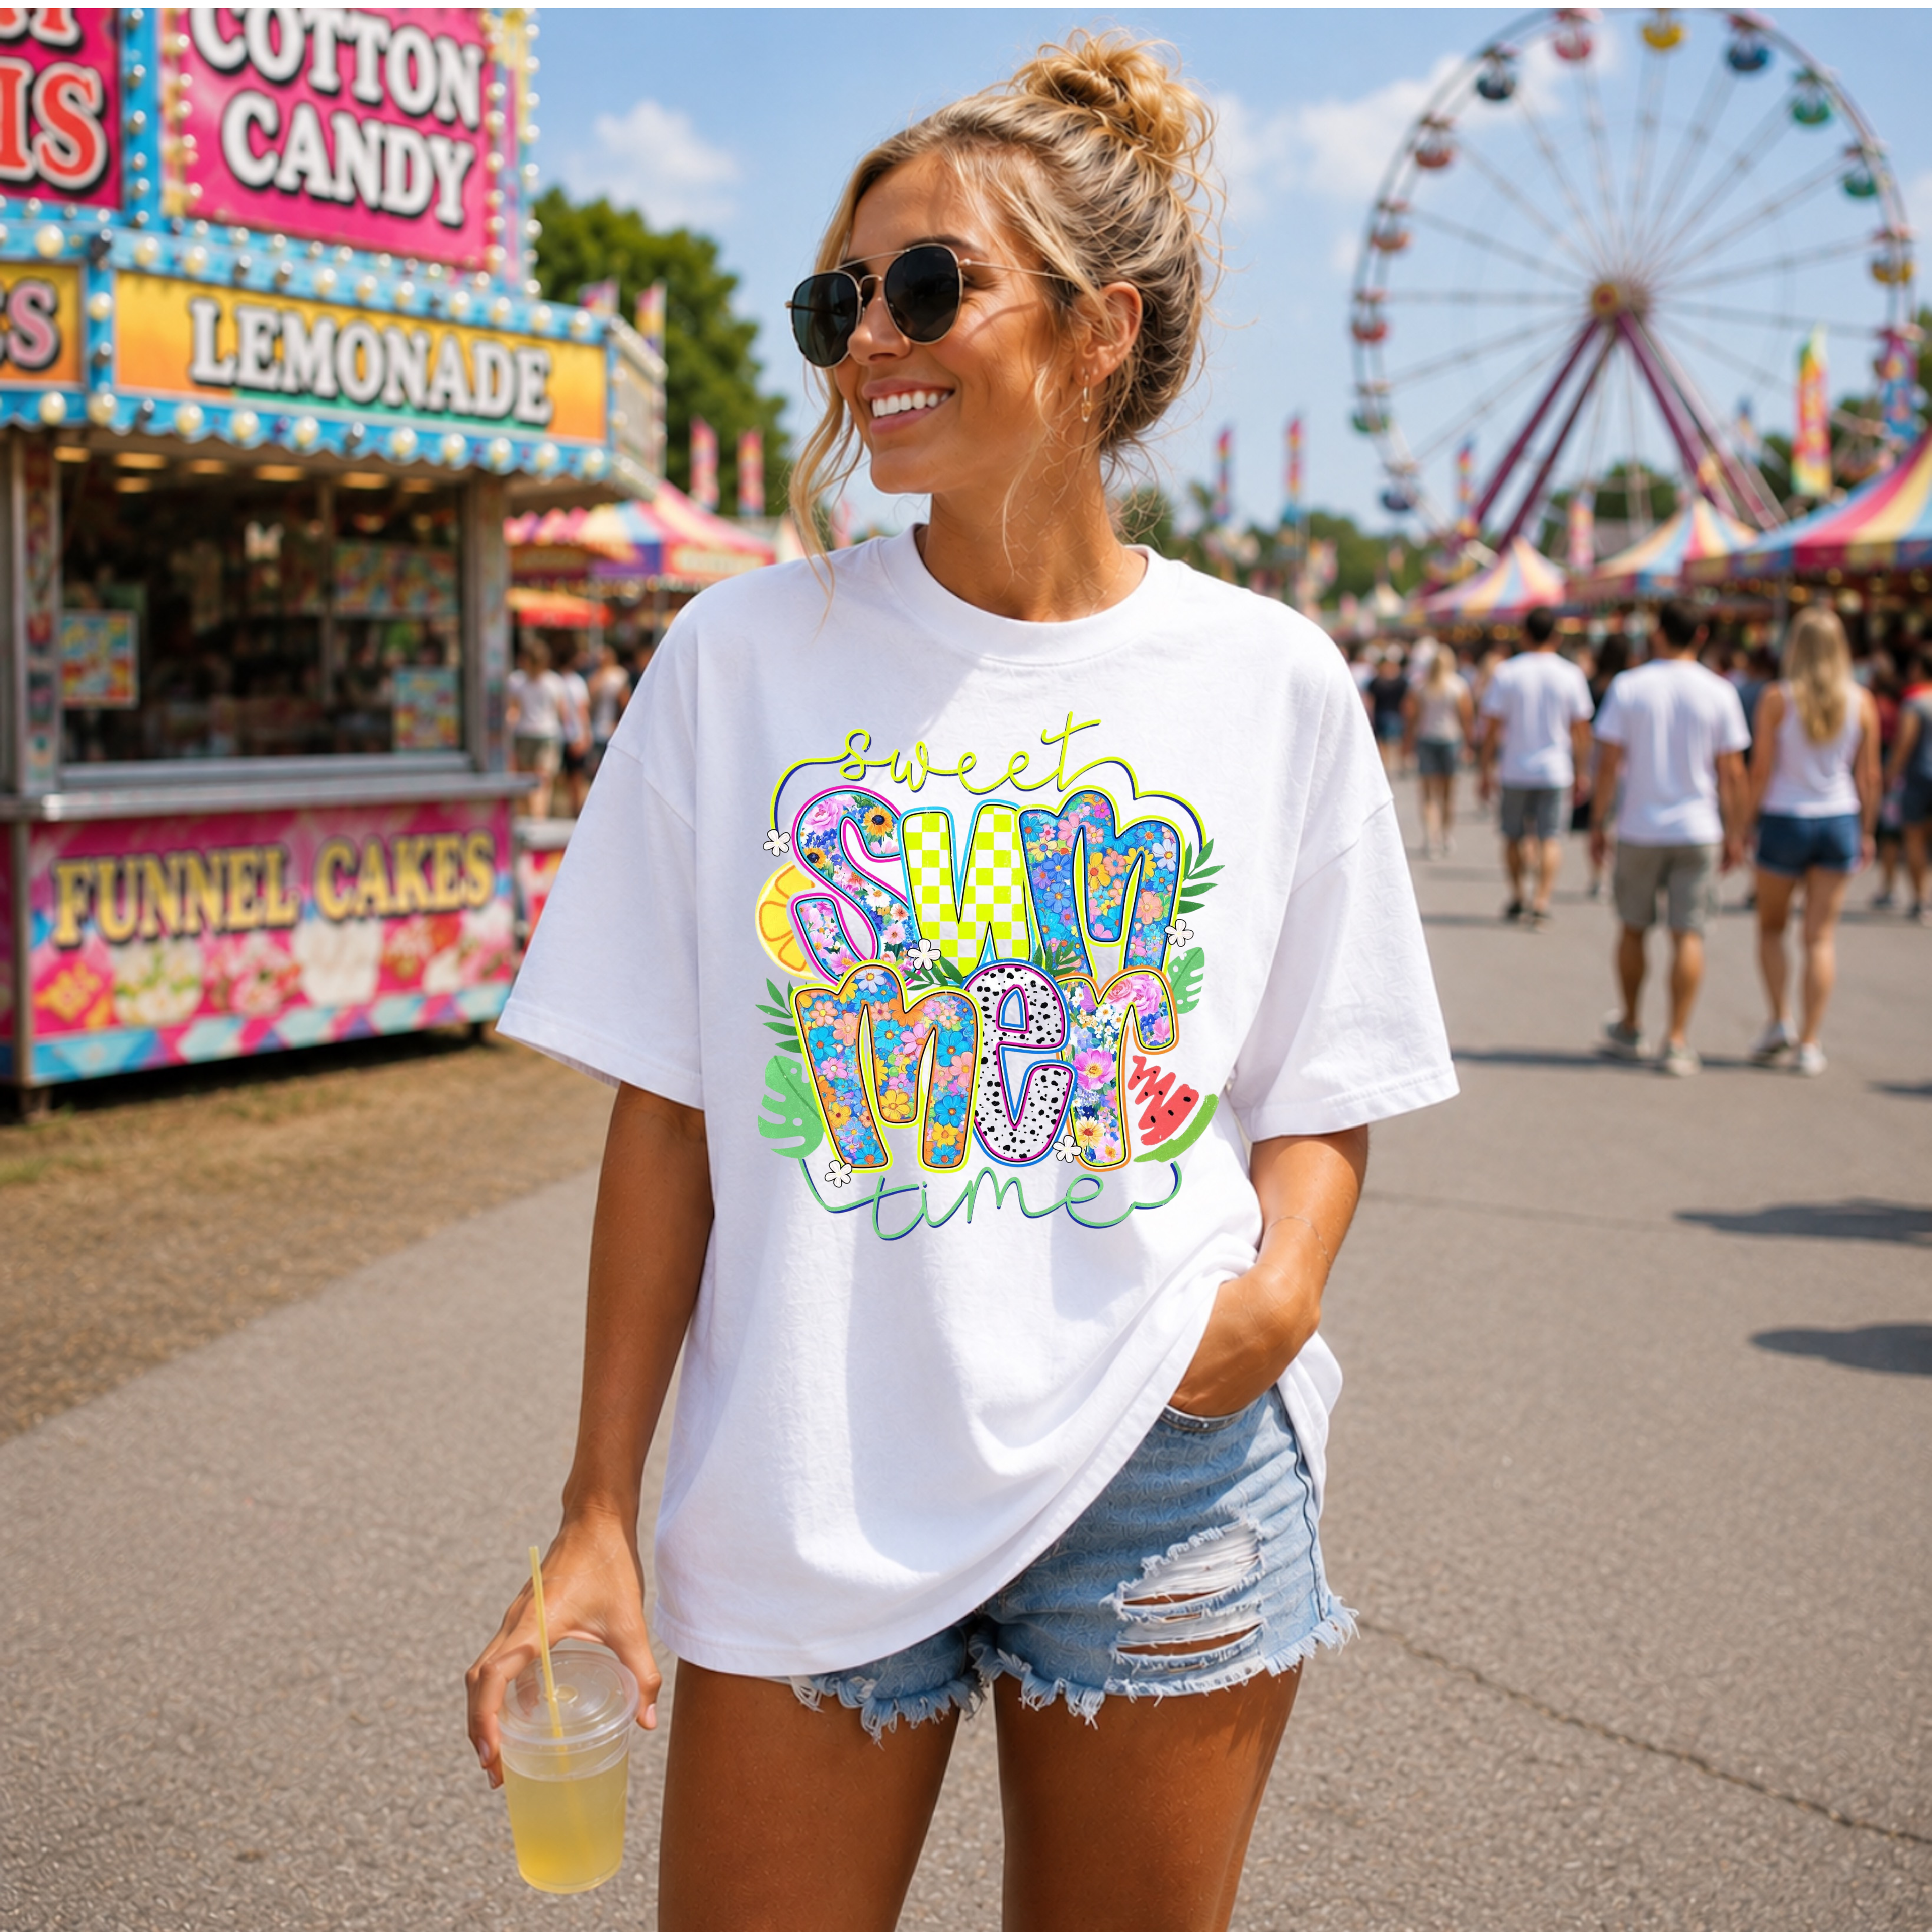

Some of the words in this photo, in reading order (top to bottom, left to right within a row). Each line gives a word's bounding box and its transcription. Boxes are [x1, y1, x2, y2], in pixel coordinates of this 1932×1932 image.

[189, 8, 483, 132] COTTON
[220, 89, 475, 228] CANDY
[190, 299, 552, 426] LEMONADE
[53, 843, 299, 948] FUNNEL
[314, 829, 496, 922] CAKES
